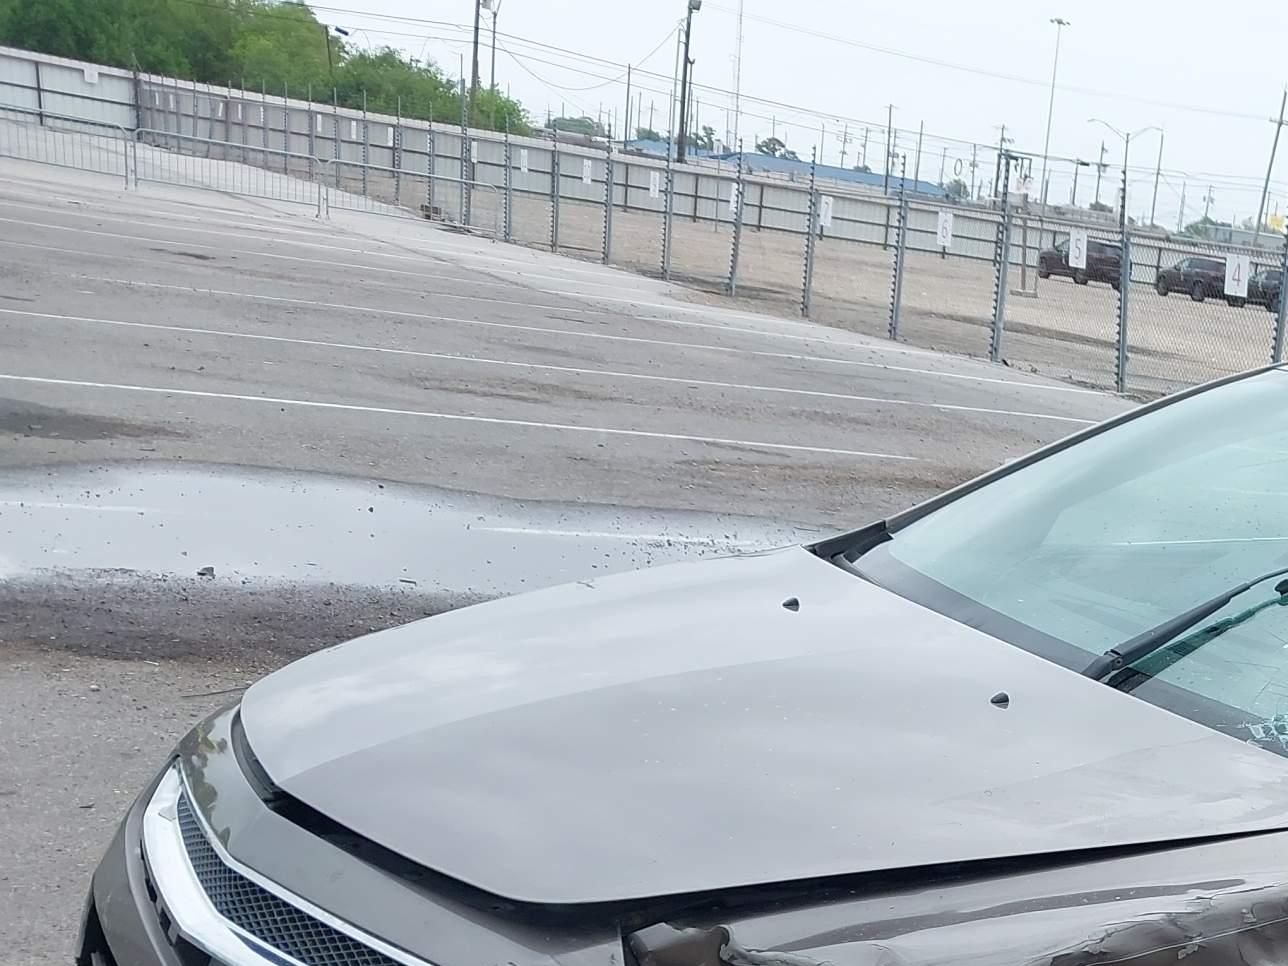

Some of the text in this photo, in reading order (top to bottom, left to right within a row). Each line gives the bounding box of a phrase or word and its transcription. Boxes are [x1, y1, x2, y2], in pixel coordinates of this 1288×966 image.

[941, 219, 949, 240] 6
[1073, 238, 1082, 260] 5
[1231, 262, 1242, 287] 4
